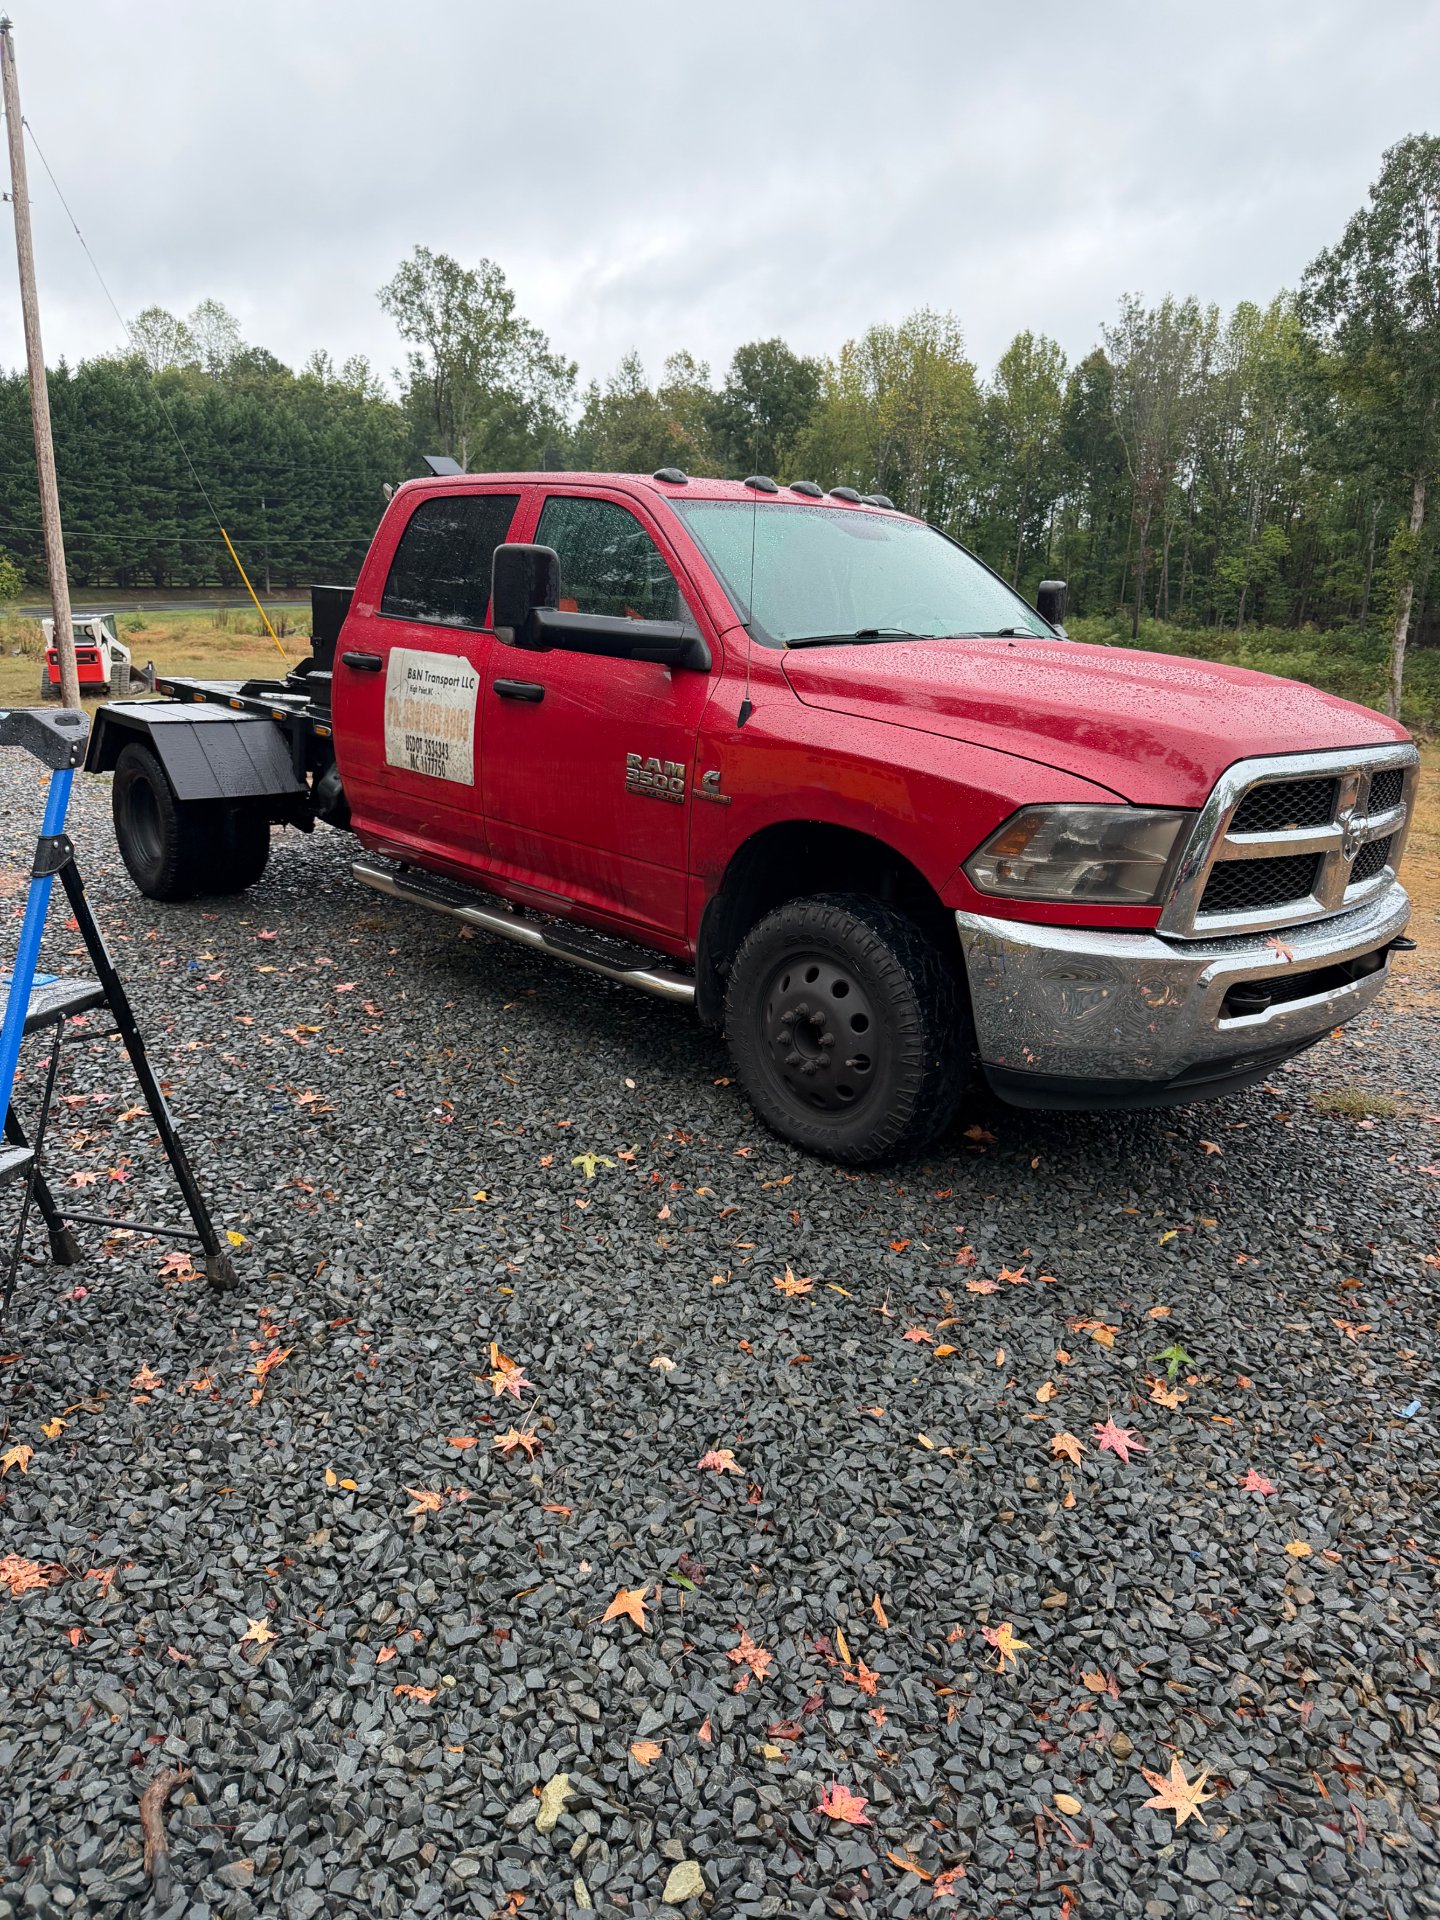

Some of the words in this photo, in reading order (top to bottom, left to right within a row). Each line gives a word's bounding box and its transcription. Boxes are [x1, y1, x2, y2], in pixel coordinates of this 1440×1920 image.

[407, 667, 423, 681] B&N
[425, 670, 460, 689] Transport
[461, 676, 475, 690] LLC
[405, 734, 423, 755] USDOT
[410, 753, 420, 771] MC
[626, 752, 686, 779] RAM
[625, 767, 685, 793] 3500
